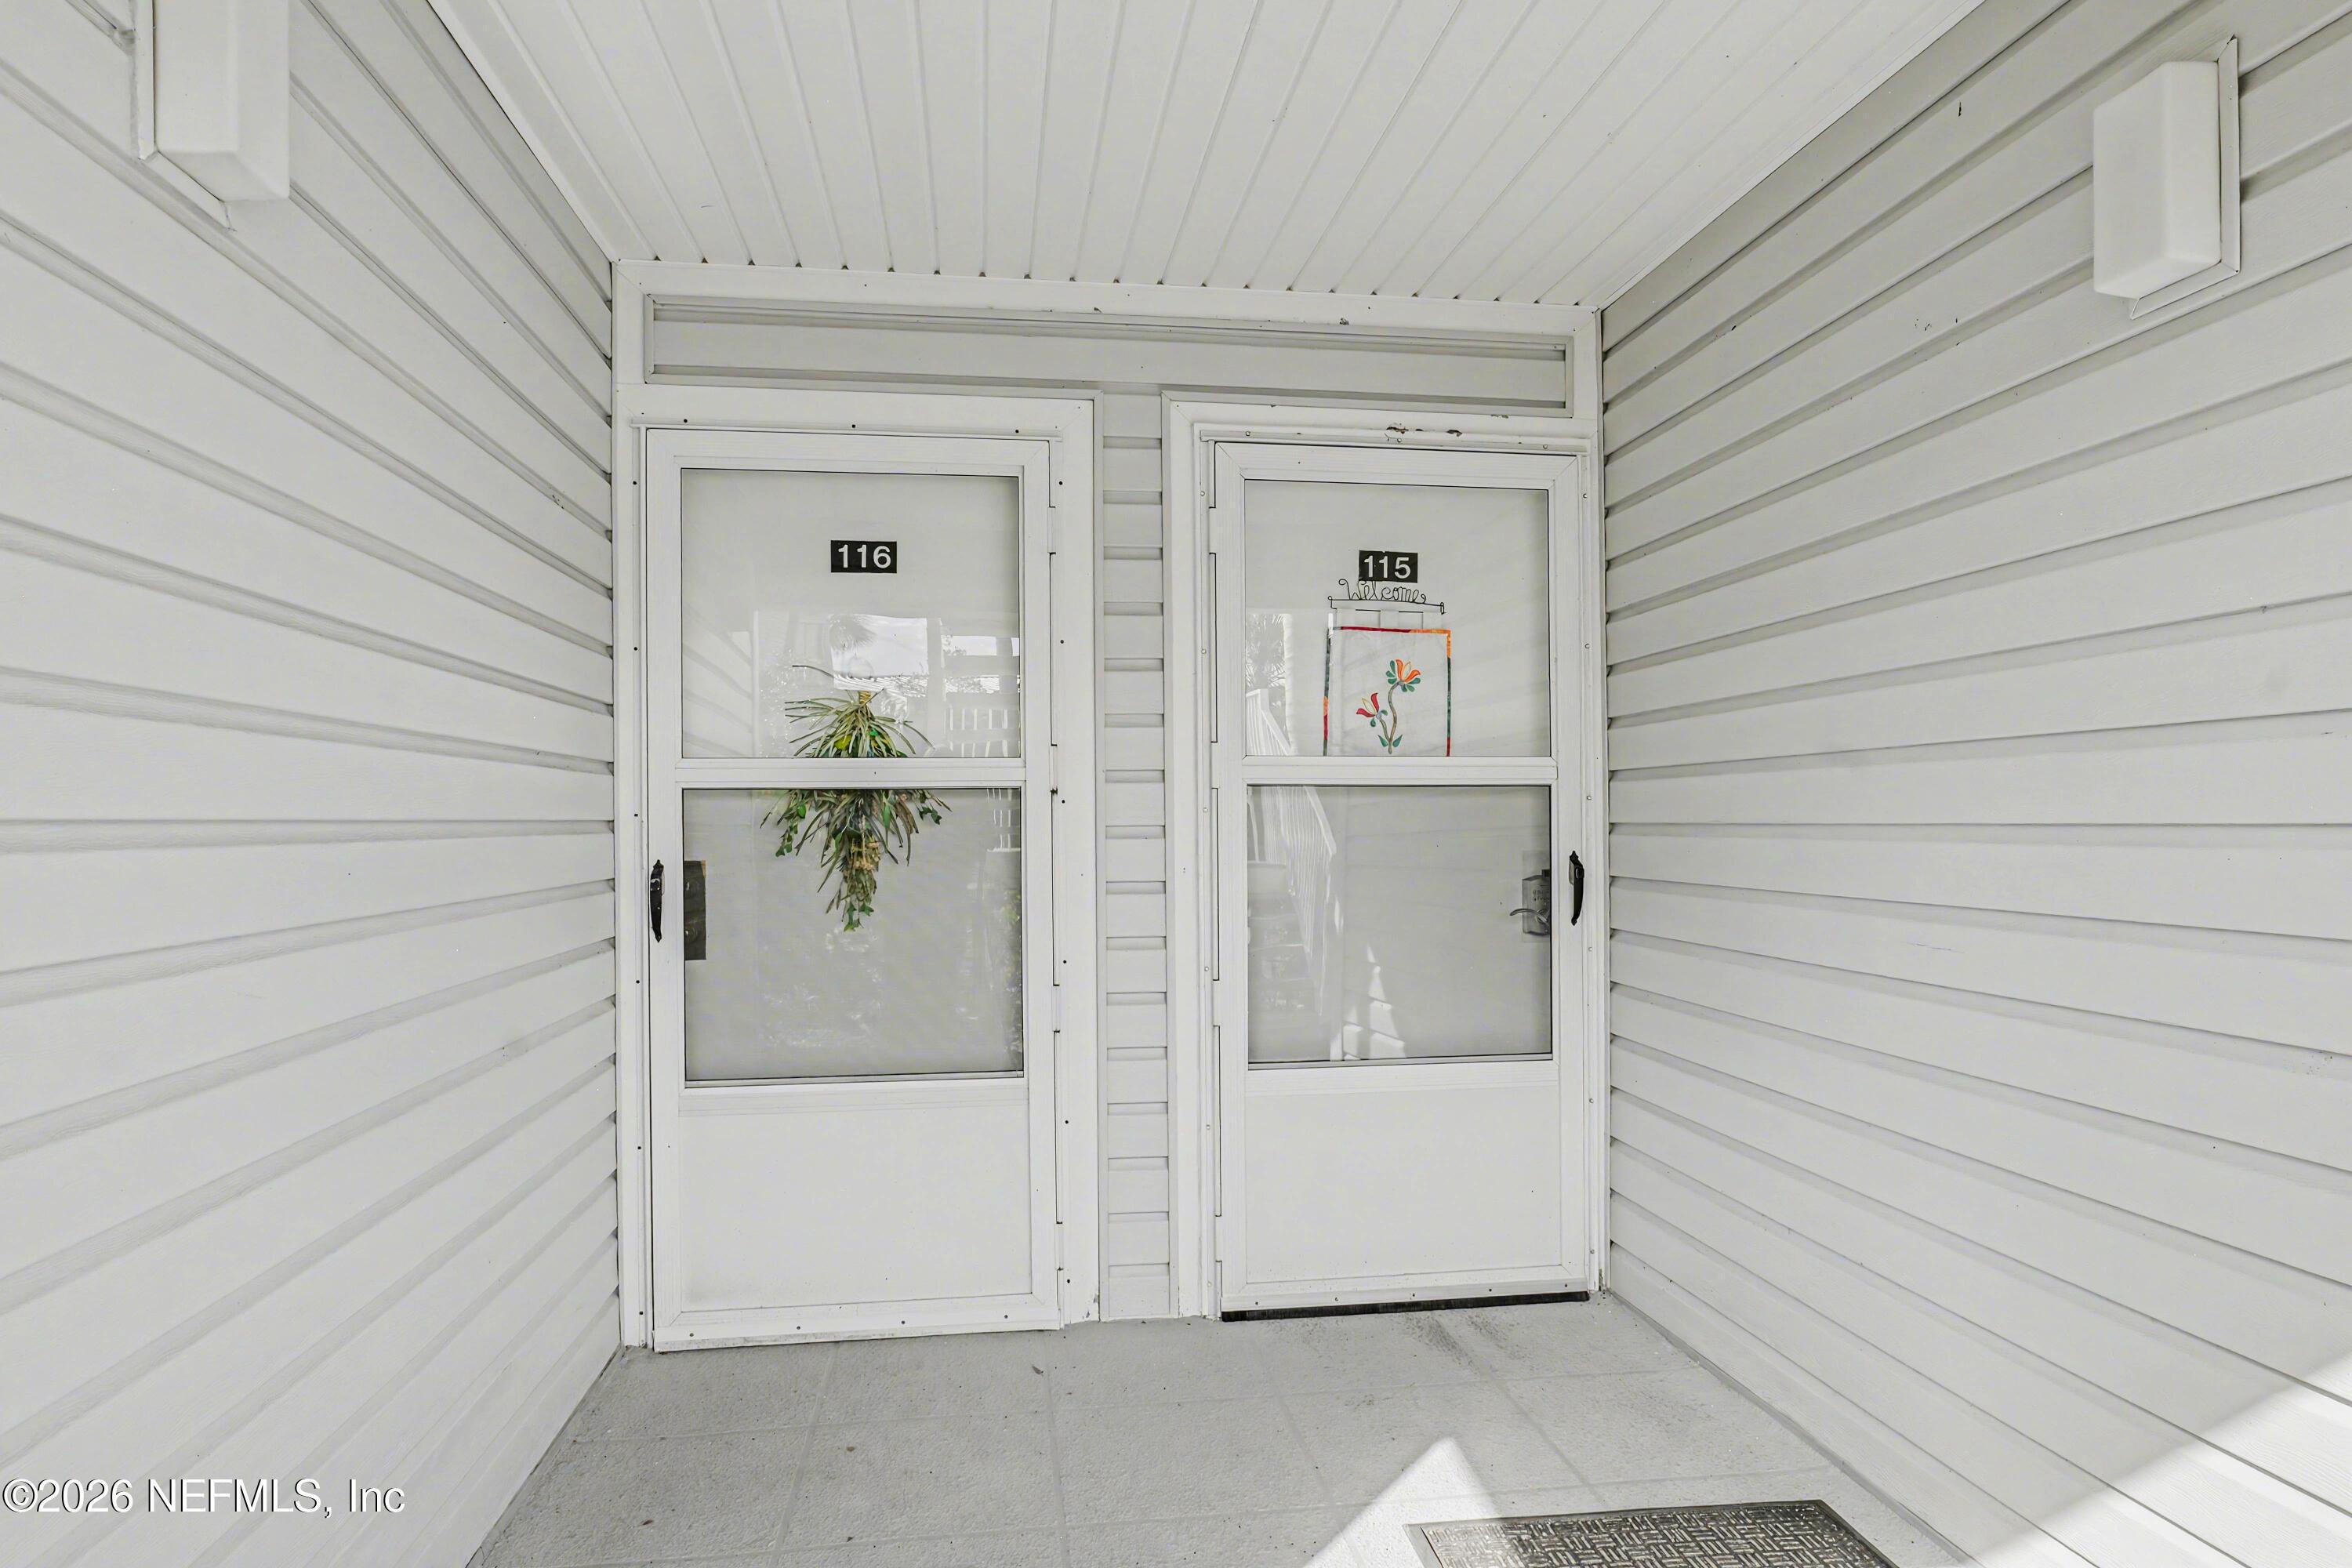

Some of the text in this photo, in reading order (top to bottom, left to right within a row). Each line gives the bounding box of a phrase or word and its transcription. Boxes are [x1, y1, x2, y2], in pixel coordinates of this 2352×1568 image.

[837, 544, 891, 569] 116
[1363, 555, 1411, 579] 115
[1338, 579, 1427, 604] Welcome
